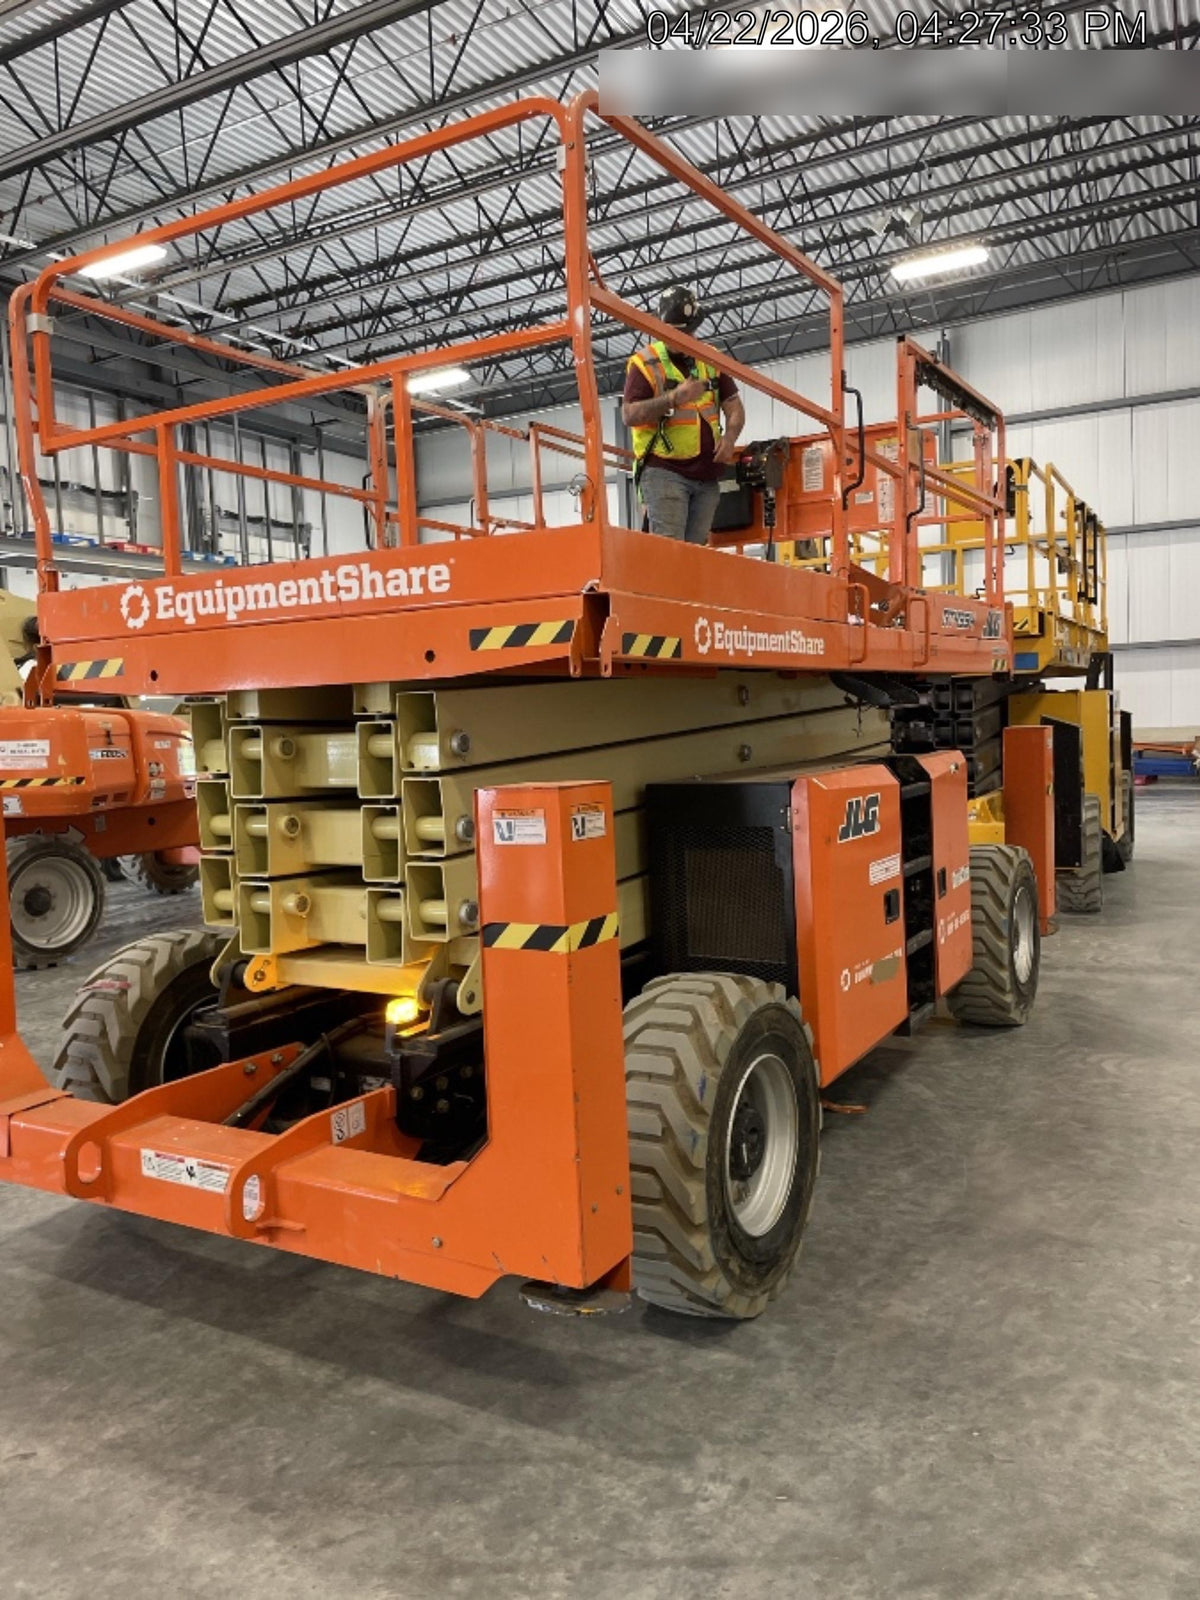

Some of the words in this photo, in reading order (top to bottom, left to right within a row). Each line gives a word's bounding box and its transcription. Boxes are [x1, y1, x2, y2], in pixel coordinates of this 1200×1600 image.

[154, 563, 451, 625] EquipmentShare
[713, 621, 825, 657] EquipmentShare
[837, 792, 881, 844] JLG
